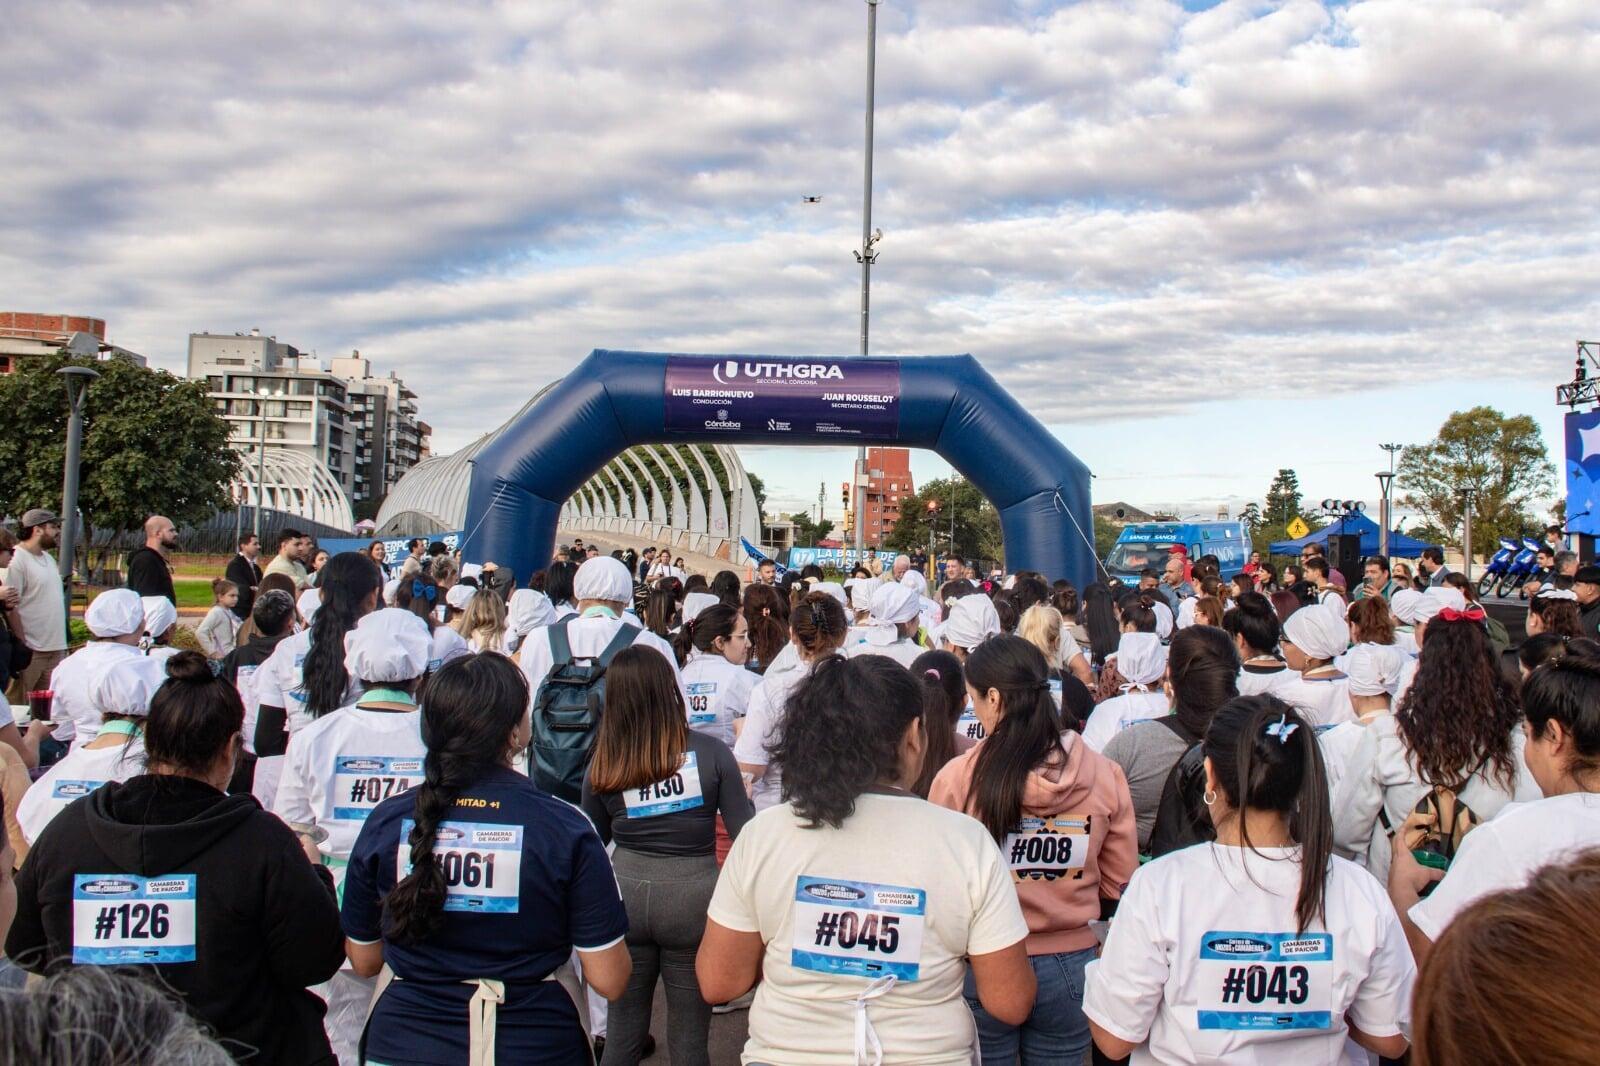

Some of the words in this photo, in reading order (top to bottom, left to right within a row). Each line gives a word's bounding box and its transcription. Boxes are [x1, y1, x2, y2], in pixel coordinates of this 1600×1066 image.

[744, 363, 844, 379] UTHGRA
[672, 388, 691, 397] LUIS
[692, 389, 754, 399] BARRIONUEVO
[821, 392, 845, 401] JUAN
[845, 393, 894, 403] ROUSSELOT
[704, 420, 741, 428] Córdoba
[383, 552, 397, 564] DE
[817, 549, 832, 558] LA
[880, 552, 895, 561] DE
[966, 722, 987, 740] #0
[455, 798, 486, 808] MITAD
[490, 801, 500, 809] +1
[1010, 836, 1073, 865] #008
[149, 880, 185, 888] CAMARERAS
[877, 892, 915, 900] CAMARERAS
[95, 903, 169, 939] #126
[815, 911, 900, 954] #045
[1281, 939, 1321, 948] CAMARERAS
[1222, 965, 1309, 1005] #043
